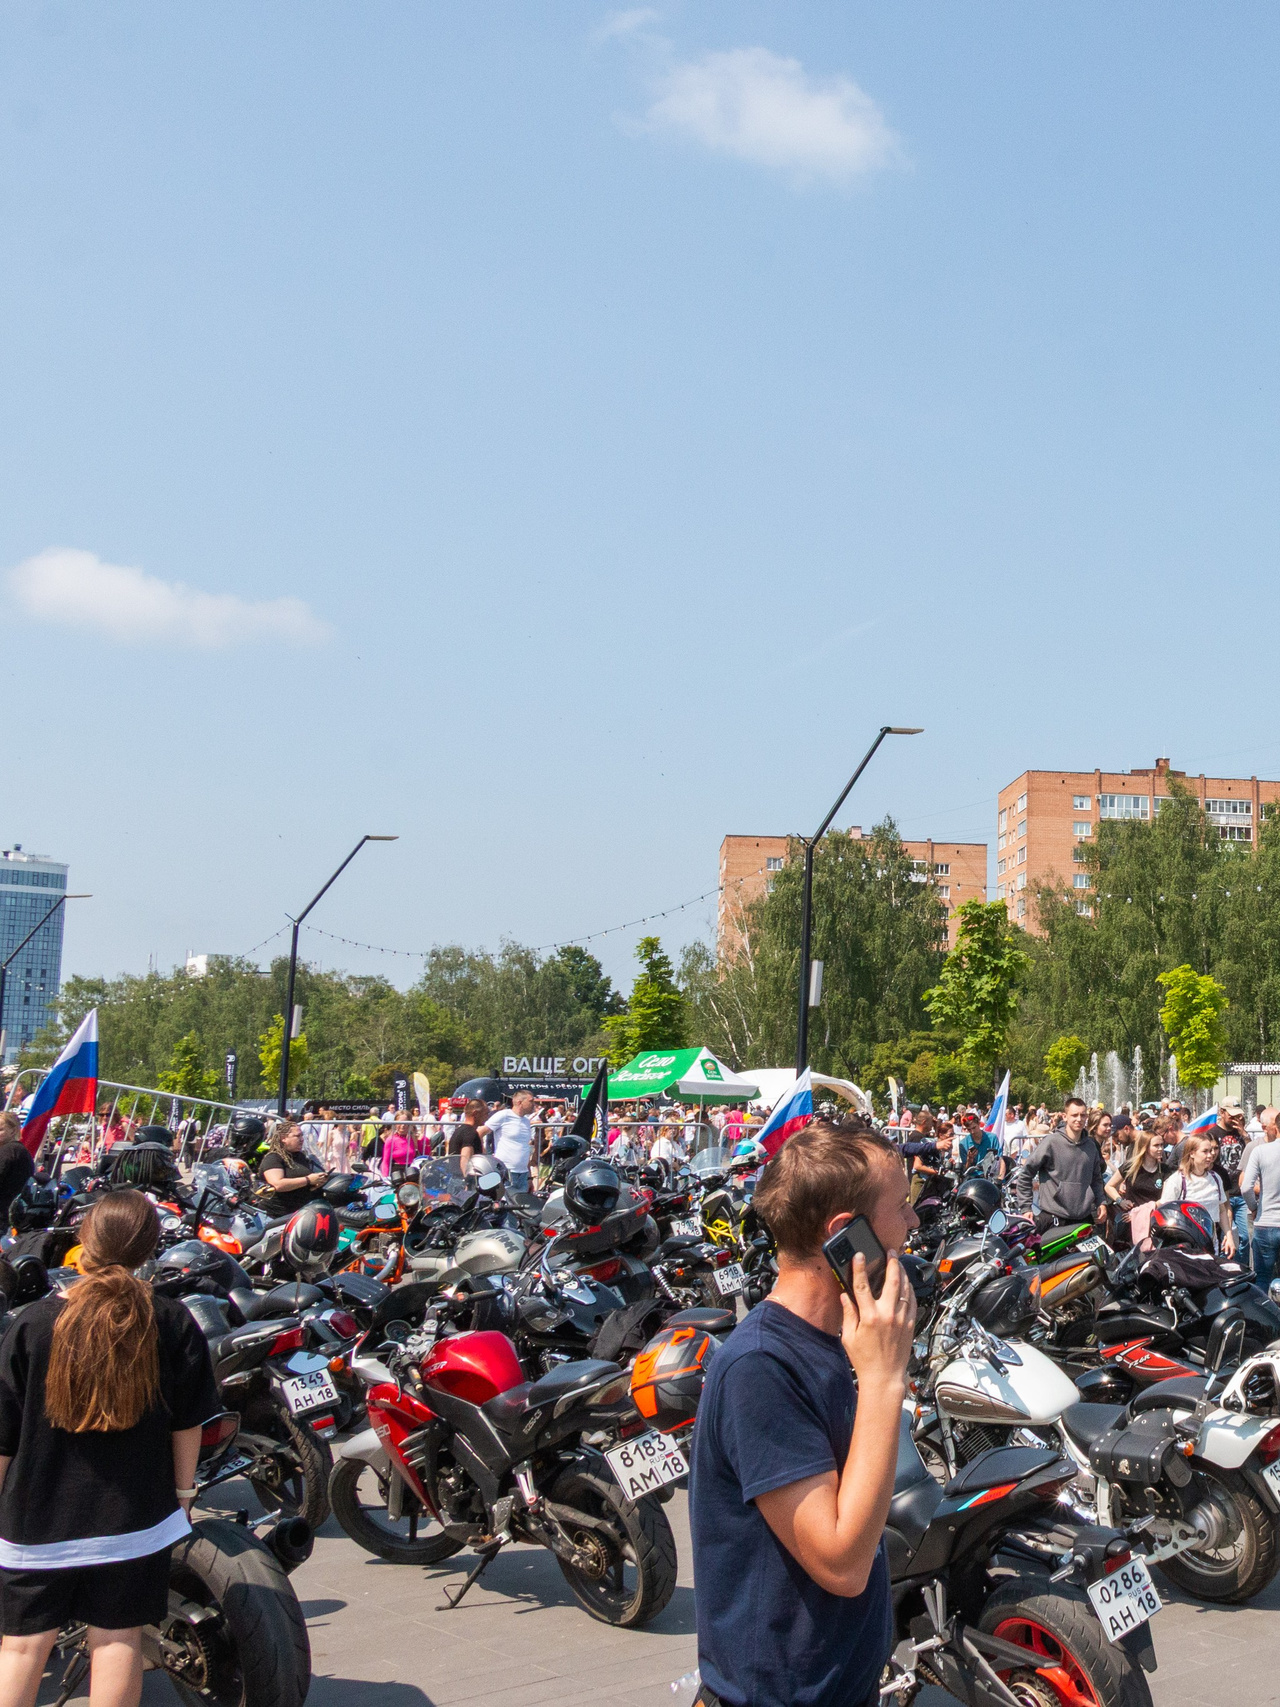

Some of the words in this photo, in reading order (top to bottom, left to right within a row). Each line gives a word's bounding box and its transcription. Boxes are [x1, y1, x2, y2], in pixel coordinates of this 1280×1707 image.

[503, 1056, 566, 1074] ВАЩЕ
[290, 1372, 325, 1391] 1349
[317, 1387, 334, 1401] 18
[619, 1433, 666, 1468] 8183
[649, 1453, 665, 1465] RUS
[661, 1456, 685, 1478] 18
[1099, 1565, 1143, 1604] 0286
[1127, 1587, 1142, 1600] RUS
[1137, 1591, 1157, 1614] 18
